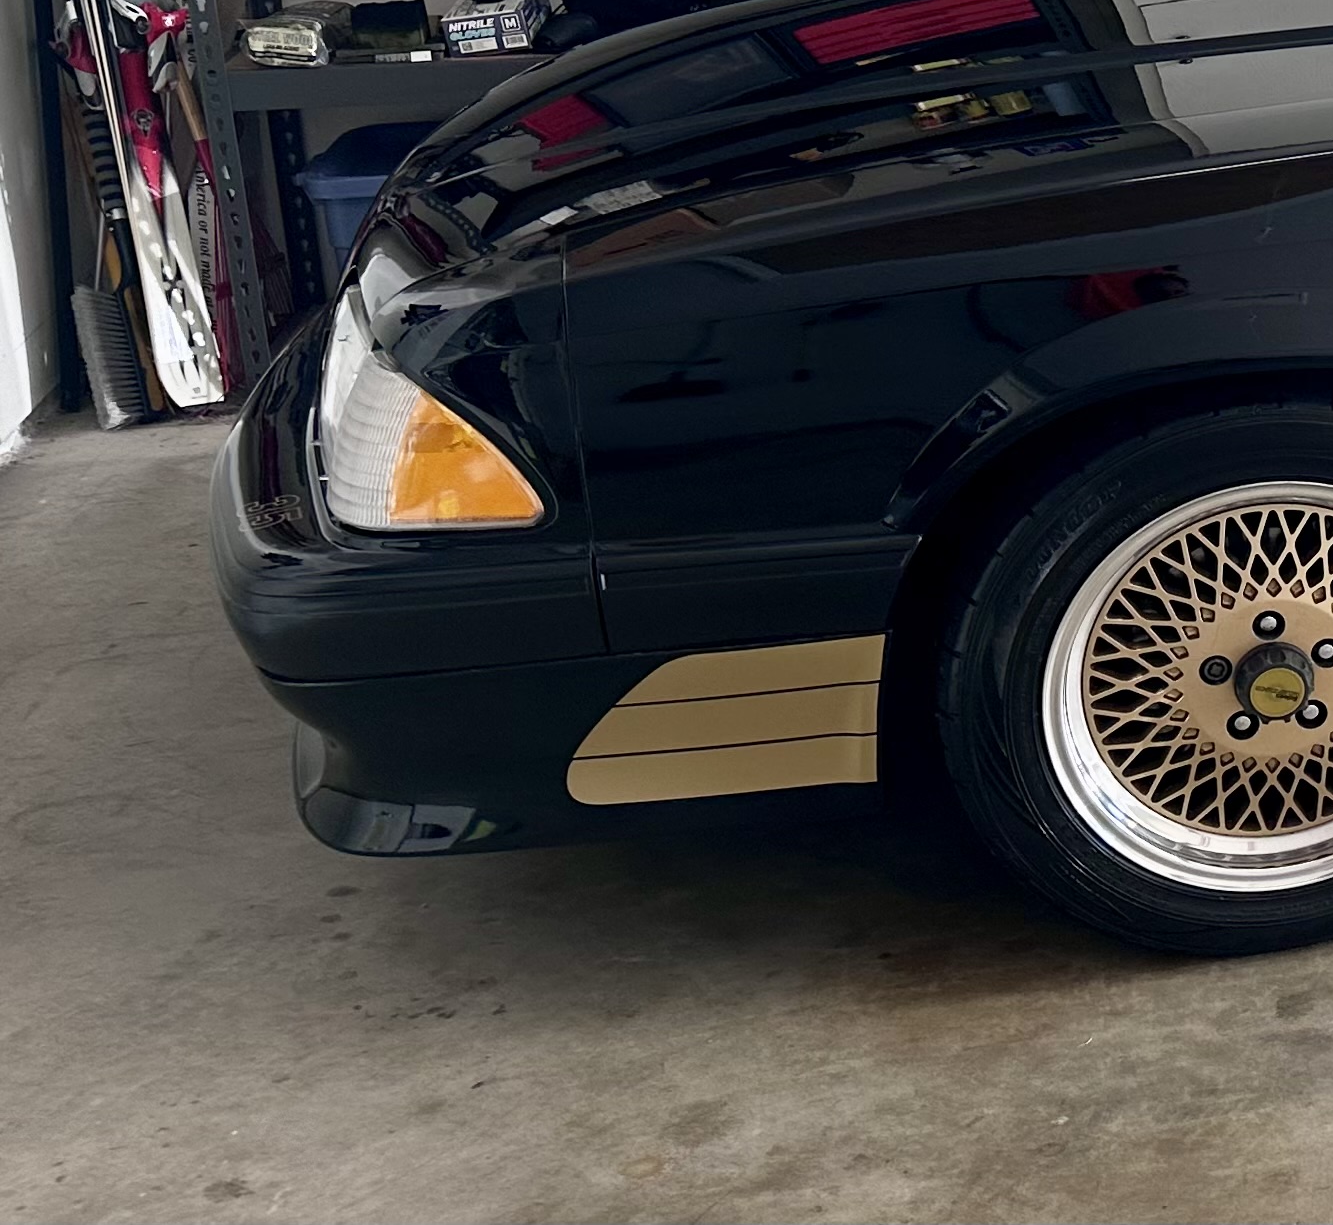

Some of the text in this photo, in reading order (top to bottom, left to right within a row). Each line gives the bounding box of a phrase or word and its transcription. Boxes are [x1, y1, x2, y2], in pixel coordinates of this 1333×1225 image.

[448, 17, 495, 33] NITRILE
[503, 17, 517, 29] M
[199, 238, 213, 258] not
